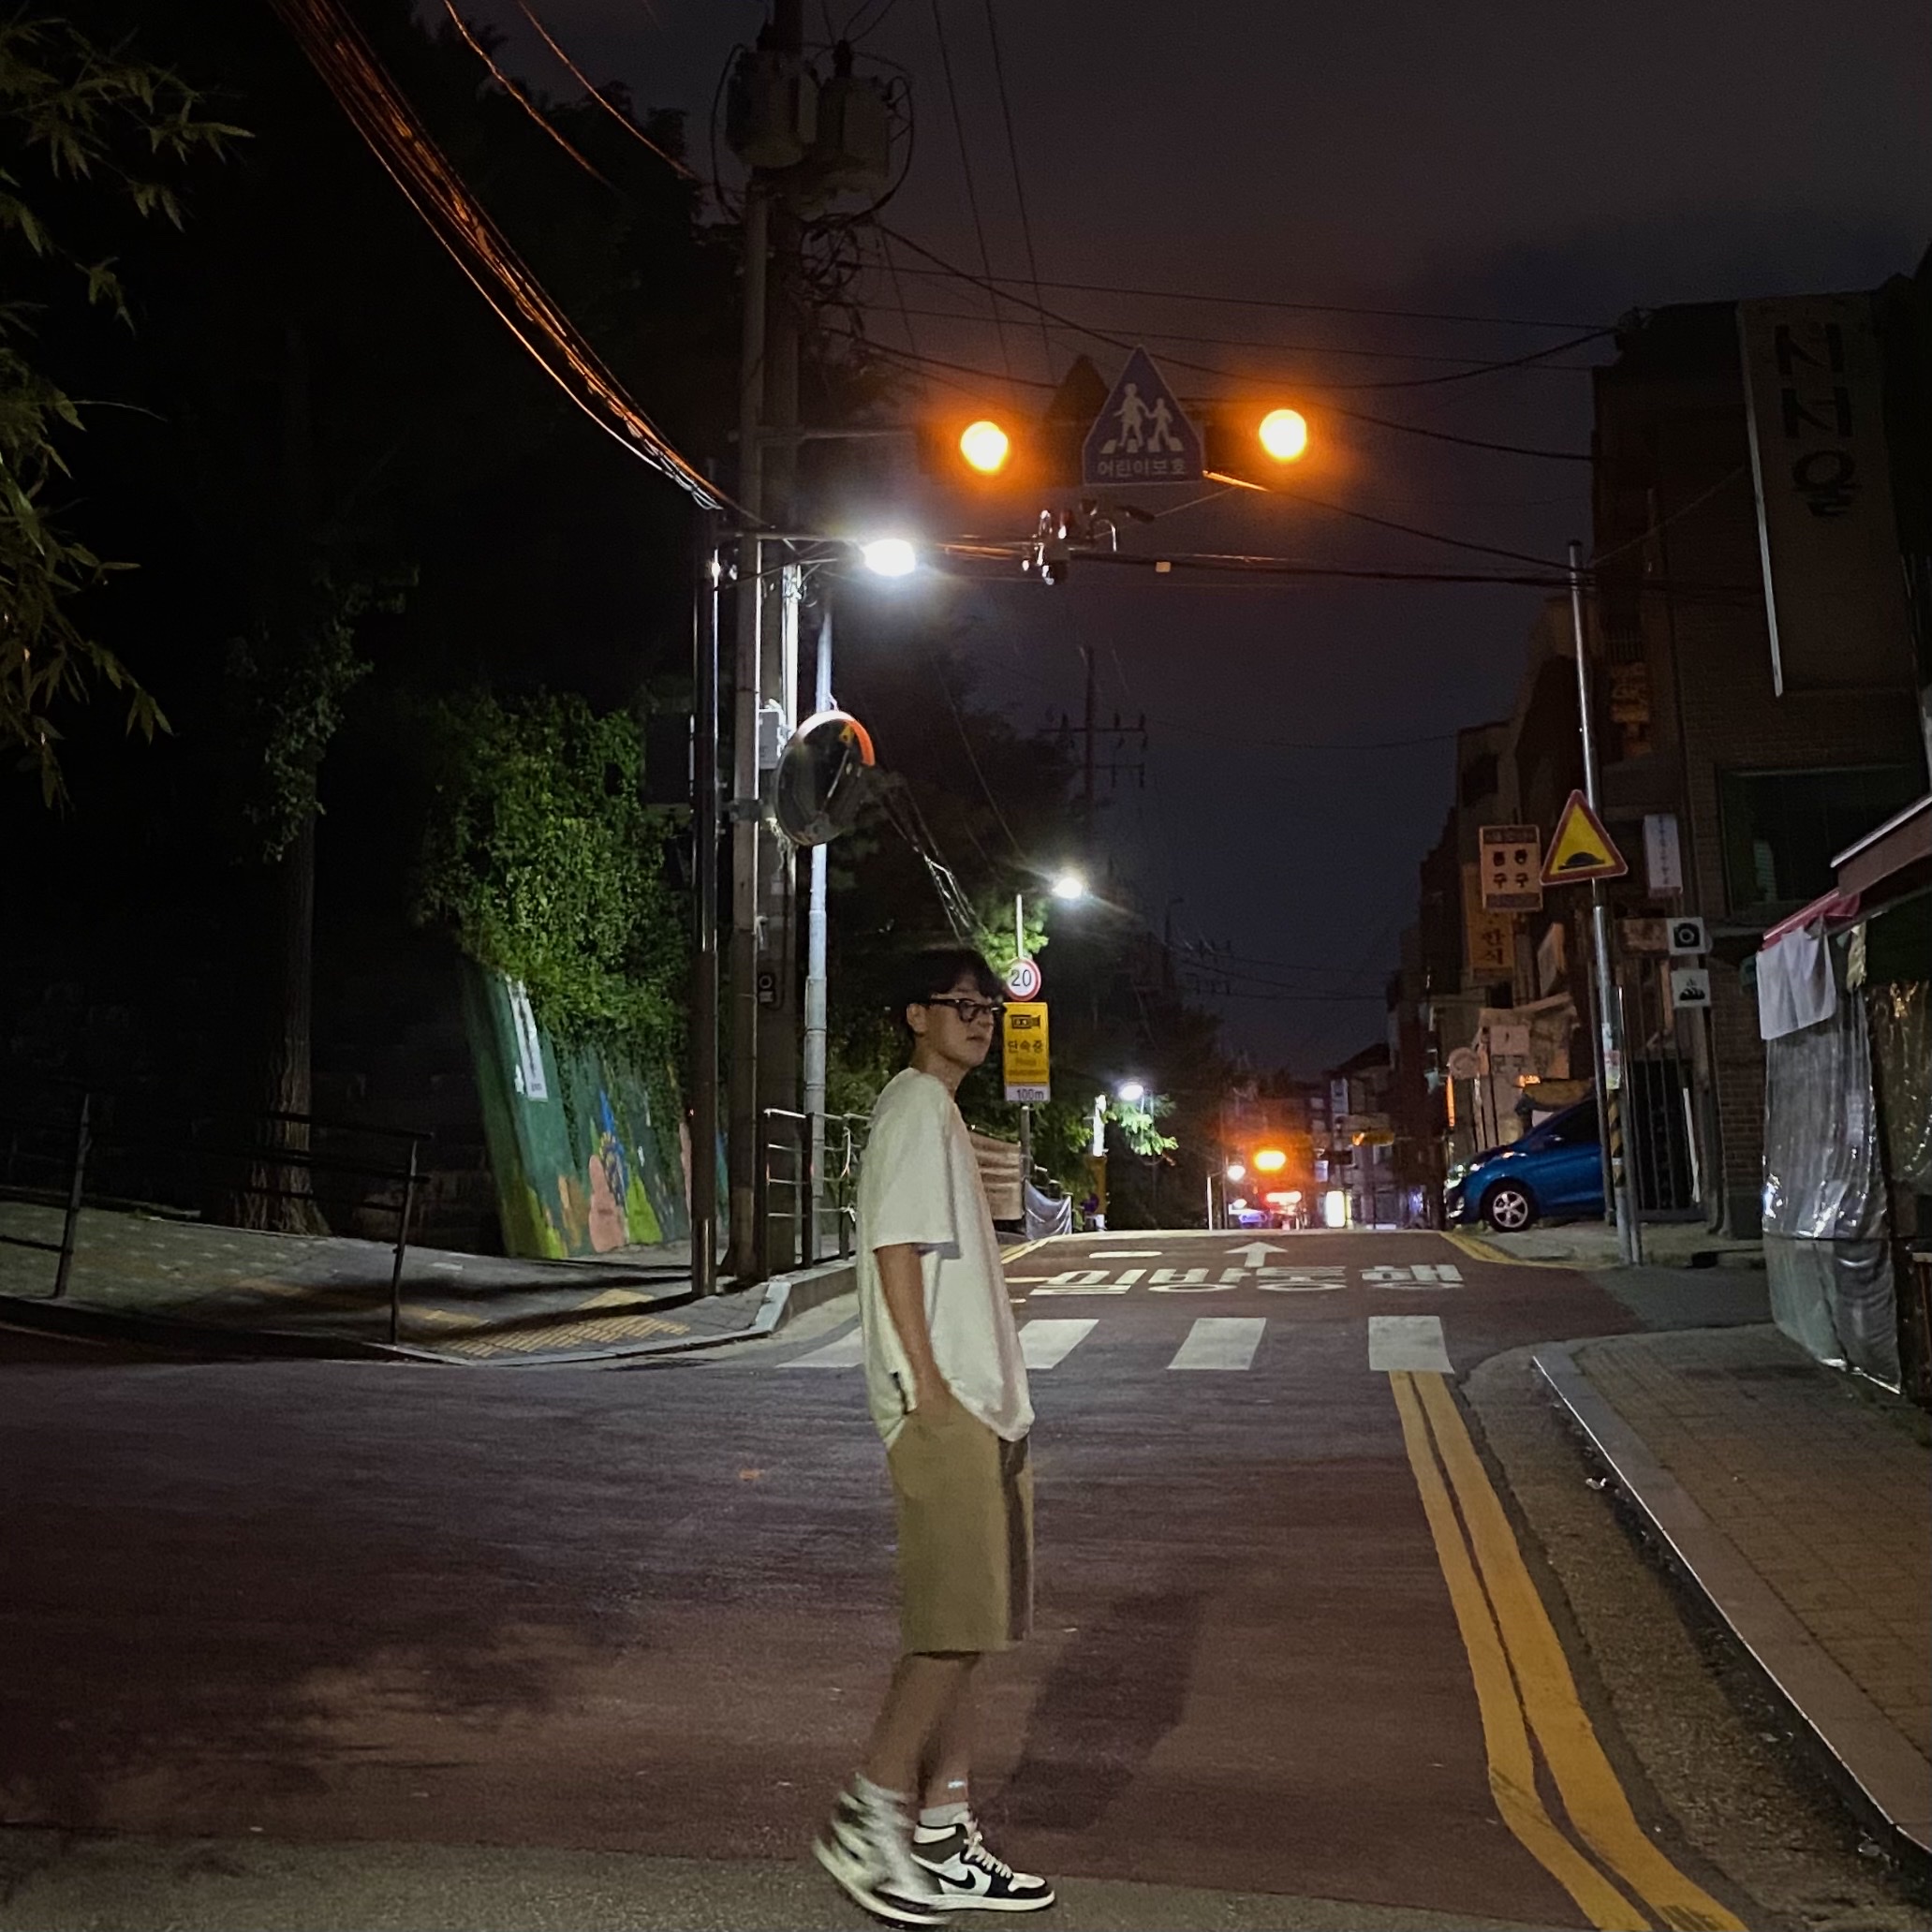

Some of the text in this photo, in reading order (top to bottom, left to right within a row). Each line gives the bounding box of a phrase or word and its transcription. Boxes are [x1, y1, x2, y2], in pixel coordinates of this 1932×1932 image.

[1097, 458, 1187, 478] 어린이보호
[1010, 968, 1032, 987] 20
[1016, 1089, 1044, 1100] 100m
[1030, 1264, 1465, 1295] 일방통행
